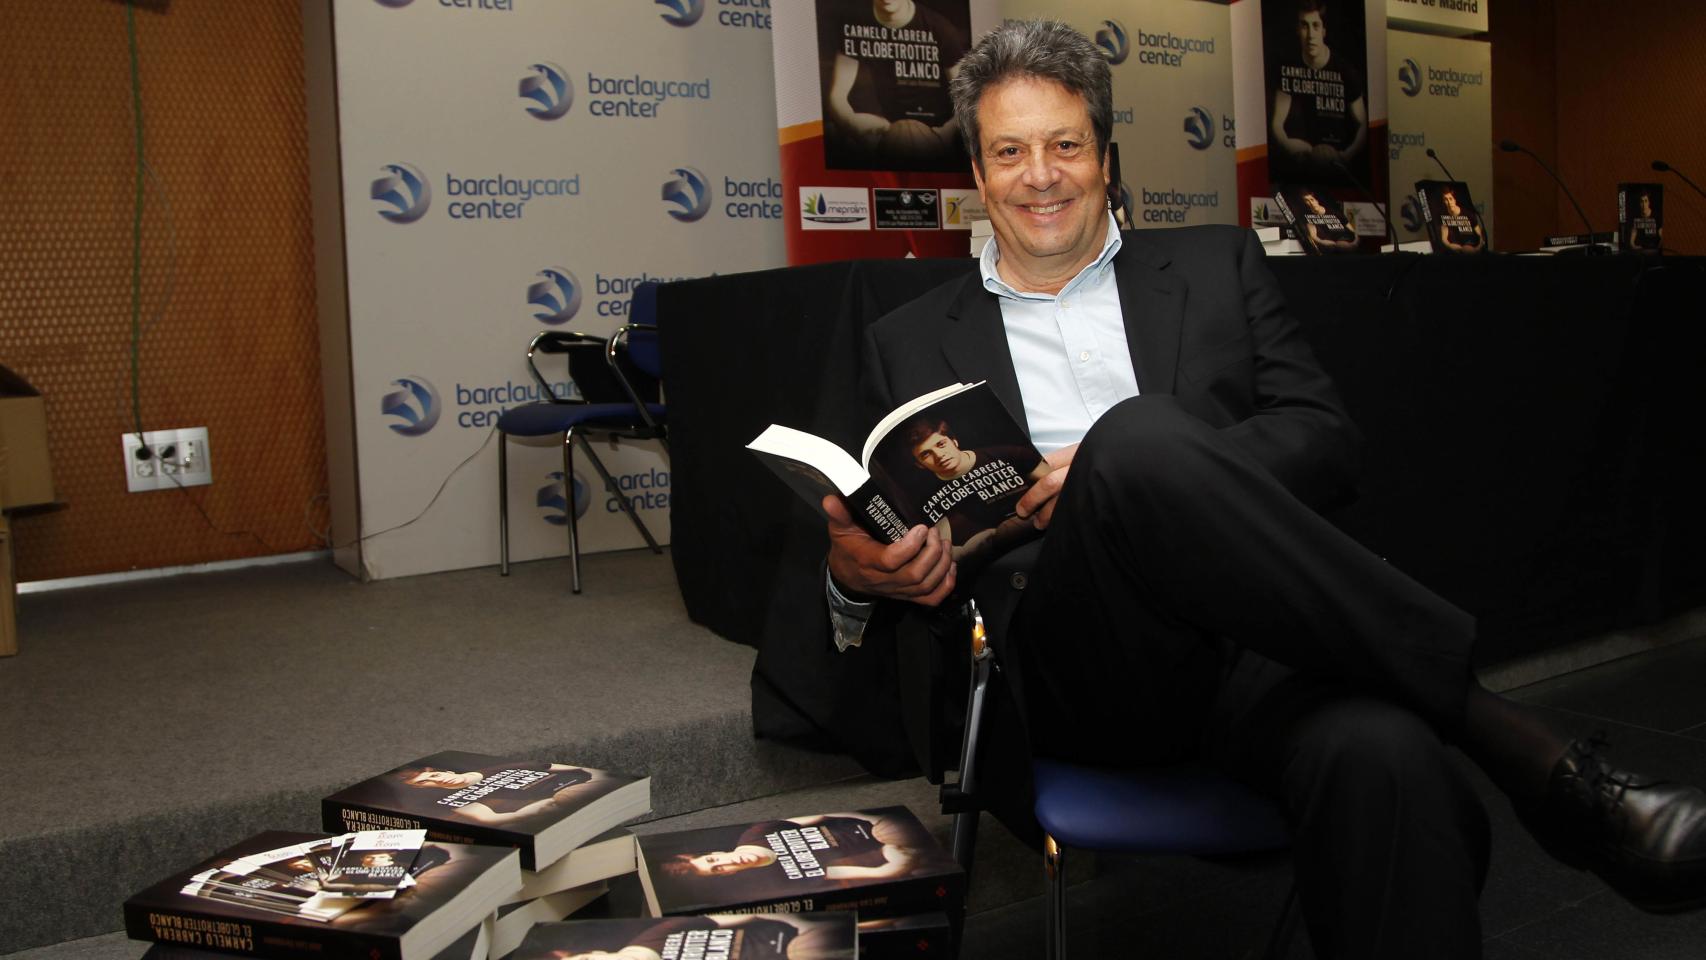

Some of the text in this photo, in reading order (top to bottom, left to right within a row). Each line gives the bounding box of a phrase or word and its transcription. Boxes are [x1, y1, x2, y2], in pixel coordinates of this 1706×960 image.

[844, 24, 938, 44] CARMELO CABRERA.
[1138, 28, 1215, 55] barclaycard
[844, 39, 940, 62] EL GLOBETROTTER
[1138, 50, 1184, 68] center
[895, 60, 940, 80] BLANCO
[1428, 66, 1483, 87] barclaycard
[588, 72, 710, 102] barclaycard
[589, 97, 660, 118] center
[447, 172, 580, 201] barclaycard
[447, 198, 525, 219] center
[1142, 187, 1219, 209] barclaycard
[1143, 207, 1187, 223] center
[456, 381, 582, 406] barclayar
[923, 479, 961, 514] CARMELO
[961, 459, 1010, 483] CABRERA.
[928, 509, 944, 524] EL
[940, 465, 1019, 511] GLOBETROTTER
[977, 474, 1026, 502] BLANCO
[872, 494, 892, 515] BLANCO
[449, 800, 471, 808] EL
[462, 769, 534, 802] GLOBETROTTER
[504, 771, 551, 790] BLANCO
[437, 783, 479, 806] CARMELO
[342, 808, 367, 822] BLANCO
[367, 813, 413, 830] GLOBETROTTER
[799, 826, 830, 851] BLANCO
[804, 898, 814, 912] EL
[150, 912, 253, 938] EL GLOBETROTTER BLANCO
[206, 933, 254, 951] CARMELO
